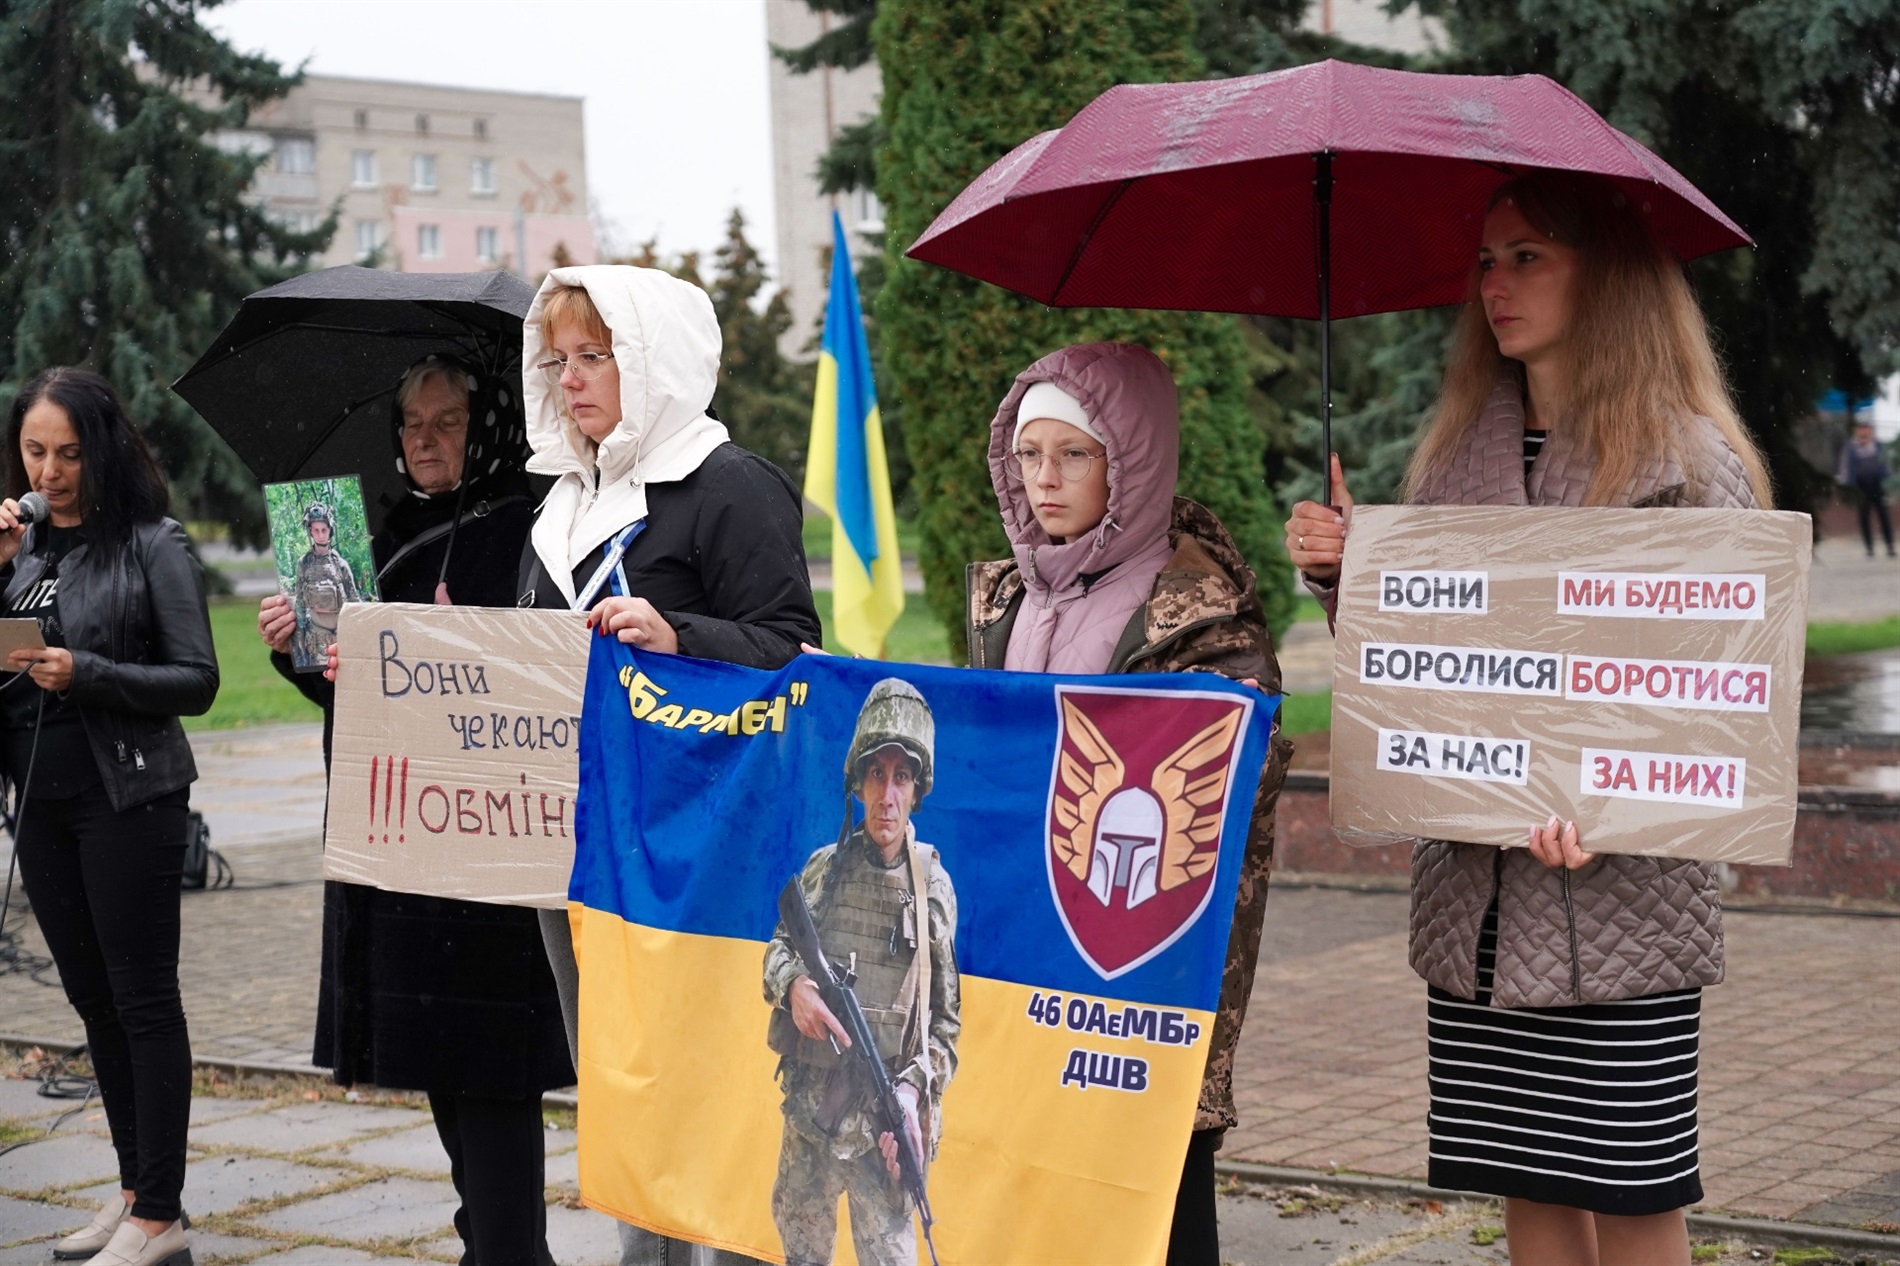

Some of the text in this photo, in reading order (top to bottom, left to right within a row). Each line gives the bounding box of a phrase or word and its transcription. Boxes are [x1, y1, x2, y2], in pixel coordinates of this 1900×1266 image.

[1382, 575, 1483, 609] ВОНИ
[1563, 578, 1756, 615] МИ БУДЕМО
[379, 629, 491, 699] Вони
[1364, 647, 1557, 690] БОРОЛИСЯ
[1571, 661, 1767, 705] БОРОТИСЯ
[1387, 733, 1524, 778] ЗА НАС!
[1592, 756, 1736, 799] ЗА НИХ!
[1028, 992, 1062, 1026] 46
[1061, 1049, 1148, 1092] ДШВ
